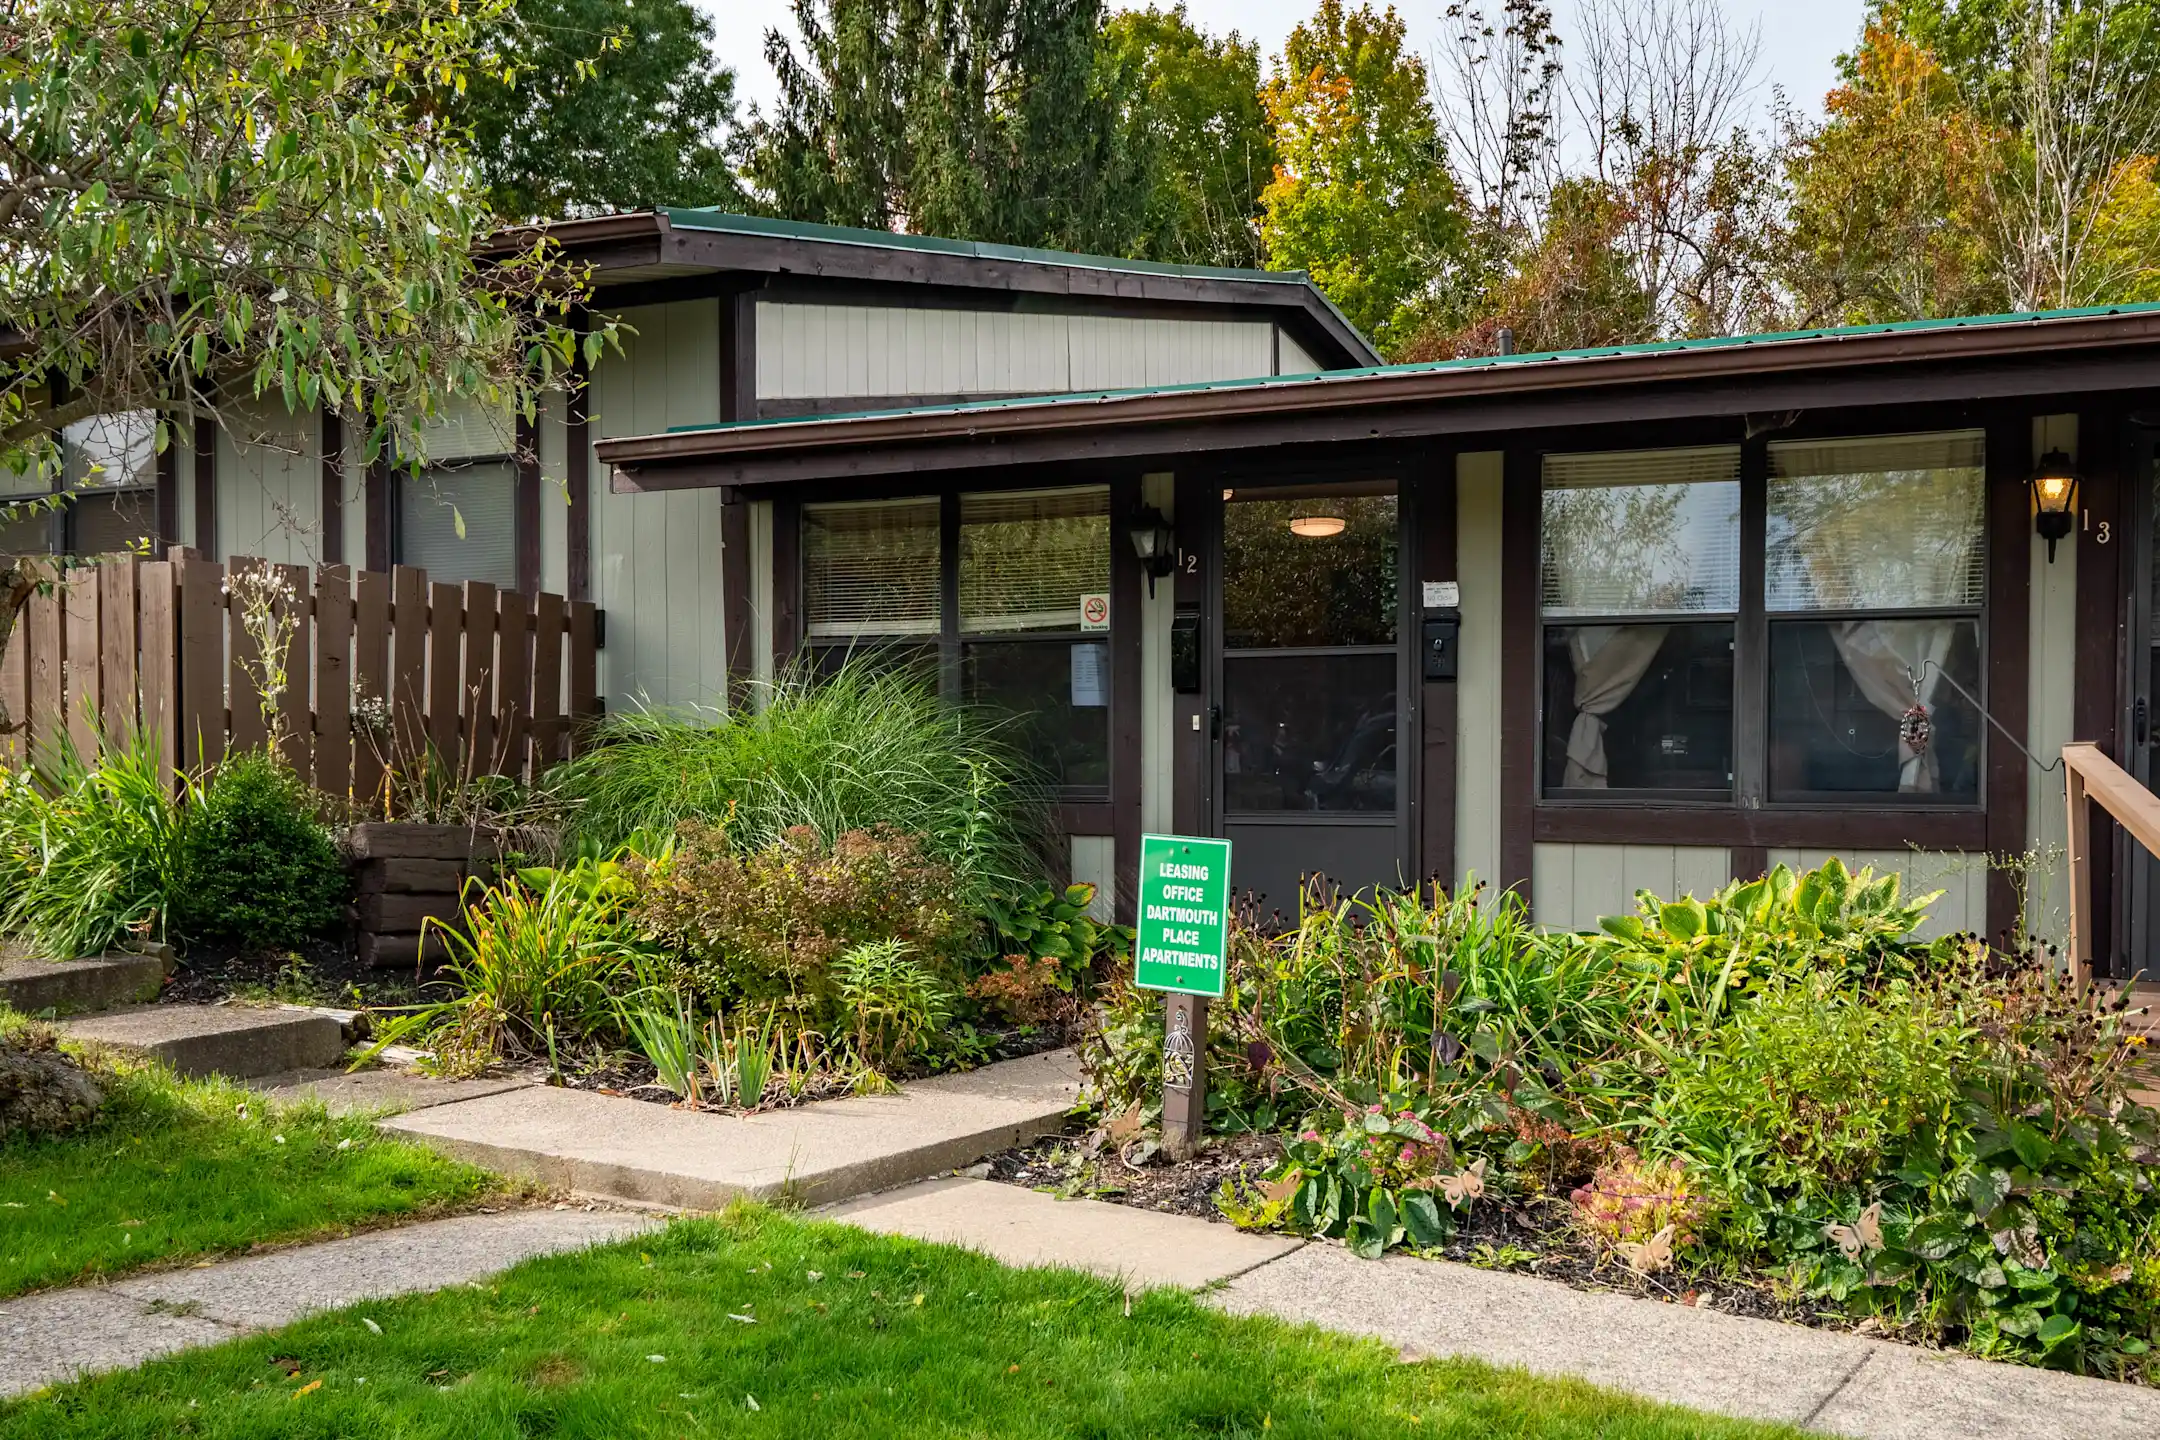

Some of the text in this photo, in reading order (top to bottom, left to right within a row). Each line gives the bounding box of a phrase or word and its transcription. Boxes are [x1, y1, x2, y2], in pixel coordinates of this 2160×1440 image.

[2083, 508, 2110, 544] 13
[1178, 547, 1197, 574] 12
[1159, 862, 1209, 881] LEASING
[1162, 884, 1204, 902] OFFICE
[1146, 904, 1218, 926] DARTMOUTH
[1162, 928, 1199, 946] PLACE
[1142, 947, 1218, 970] APARTMENTS
